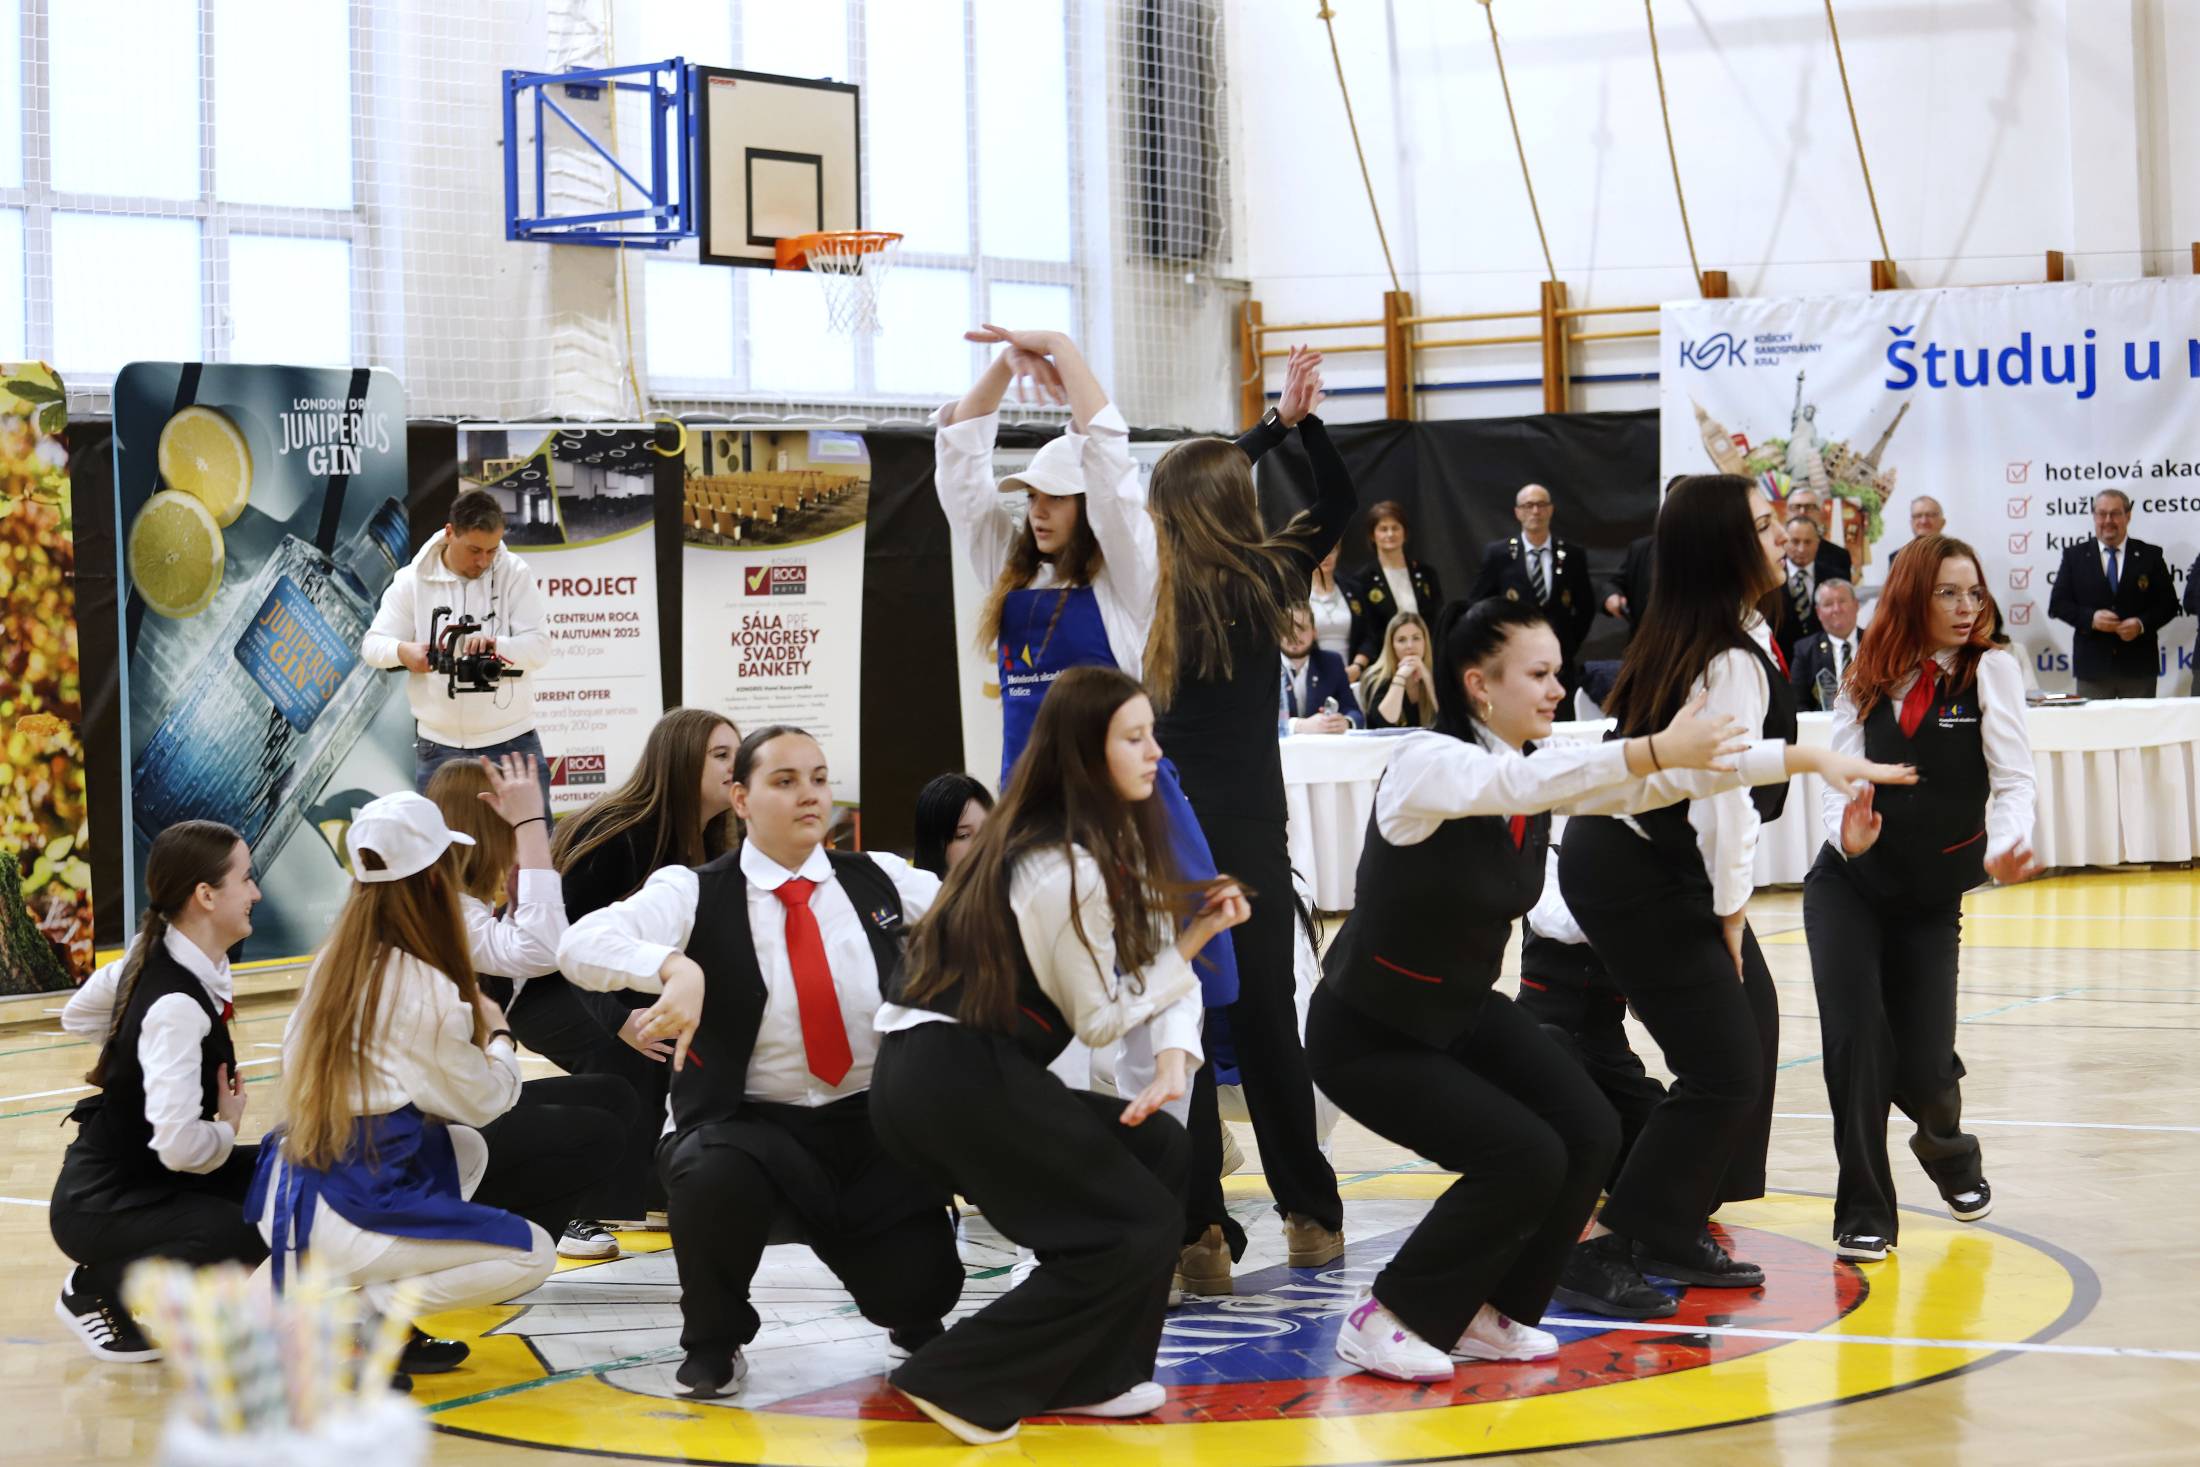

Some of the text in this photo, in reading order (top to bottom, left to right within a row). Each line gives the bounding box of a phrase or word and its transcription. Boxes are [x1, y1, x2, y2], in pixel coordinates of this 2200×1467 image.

[1885, 325, 2097, 400] Študuj
[2124, 341, 2160, 381] u
[293, 398, 373, 411] LONDON DRY
[279, 412, 390, 455] JUNIPERUS
[307, 444, 362, 476] GIN
[2046, 460, 2142, 480] hotelová
[2046, 497, 2094, 516] služ
[773, 568, 805, 580] ROCA
[548, 577, 637, 597] PROJECT
[287, 601, 322, 644] LONDON
[553, 613, 606, 624] CENTRUM
[608, 612, 640, 622] ROCA
[742, 610, 782, 630] SÁLA
[562, 629, 611, 639] AUTUMN
[614, 627, 641, 638] 2025
[731, 629, 820, 647] KONGRESY
[259, 599, 342, 701] JUNIPERUS
[743, 645, 806, 662] SVADBY
[269, 639, 311, 690] GIN
[738, 660, 811, 678] BANKETY
[534, 689, 611, 702] URRENT OFFER
[568, 757, 604, 770] ROCA
